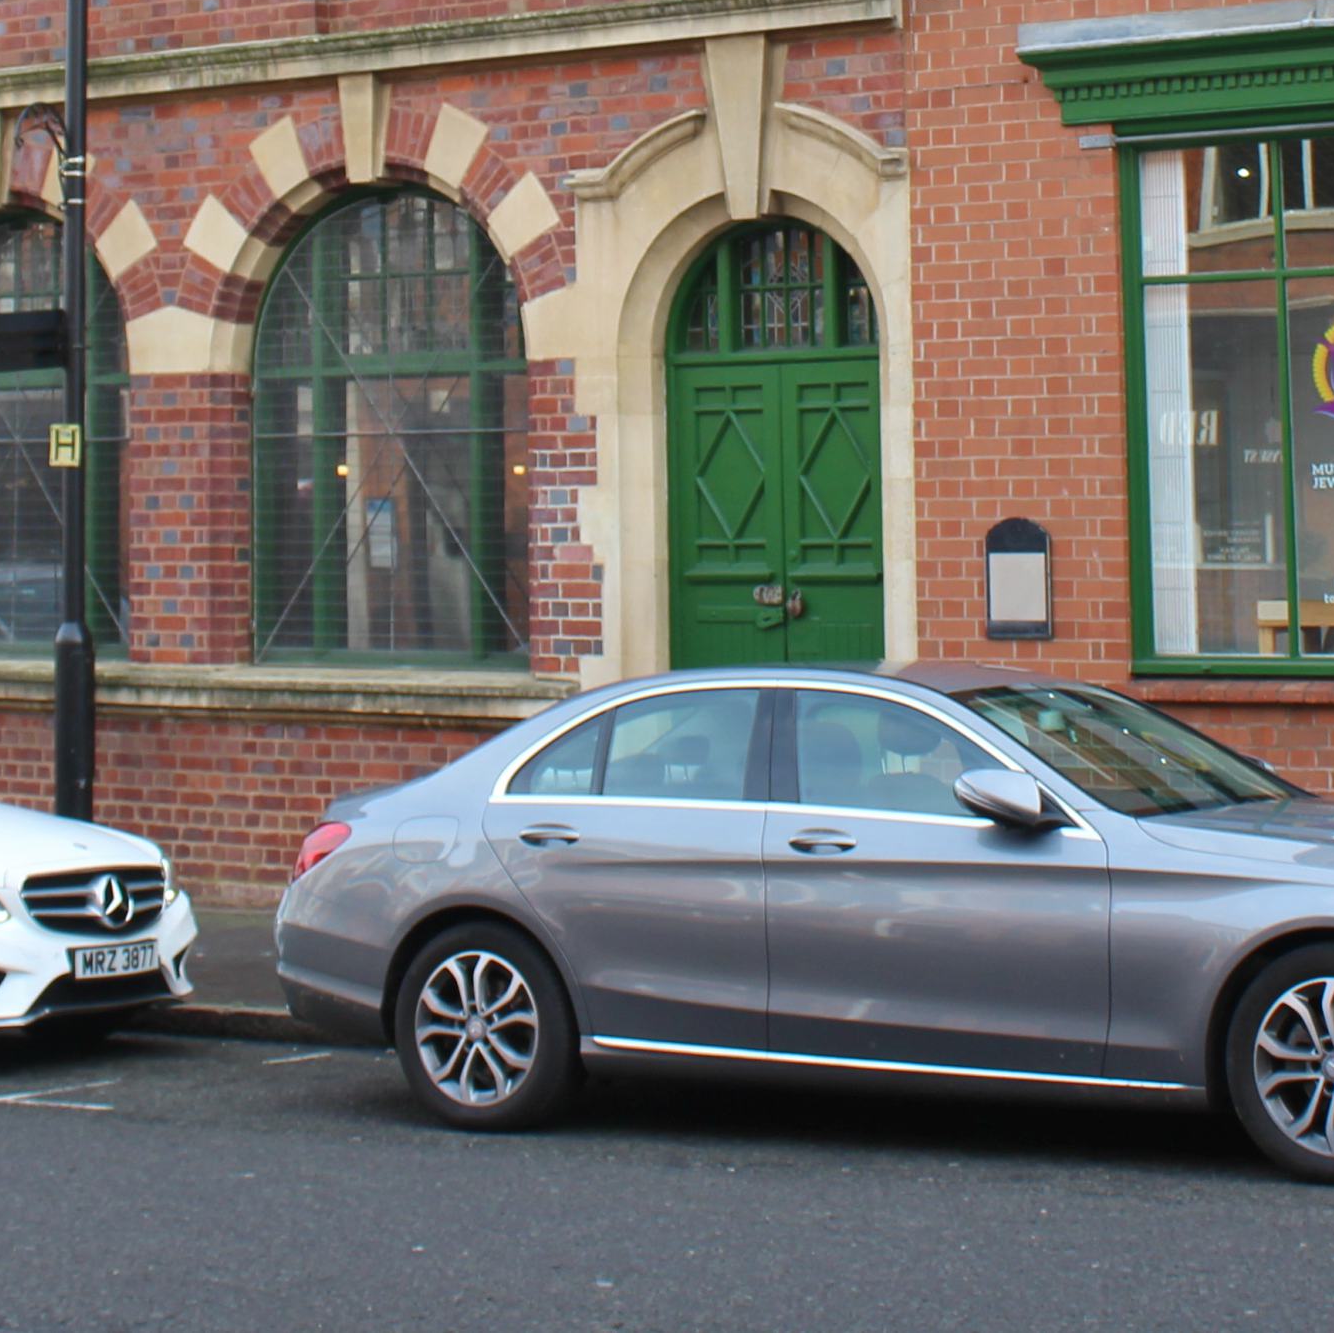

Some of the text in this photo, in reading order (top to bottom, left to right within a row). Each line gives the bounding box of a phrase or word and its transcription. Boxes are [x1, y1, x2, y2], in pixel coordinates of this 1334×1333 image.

[55, 428, 76, 462] H
[82, 944, 155, 975] MRZ 3877
